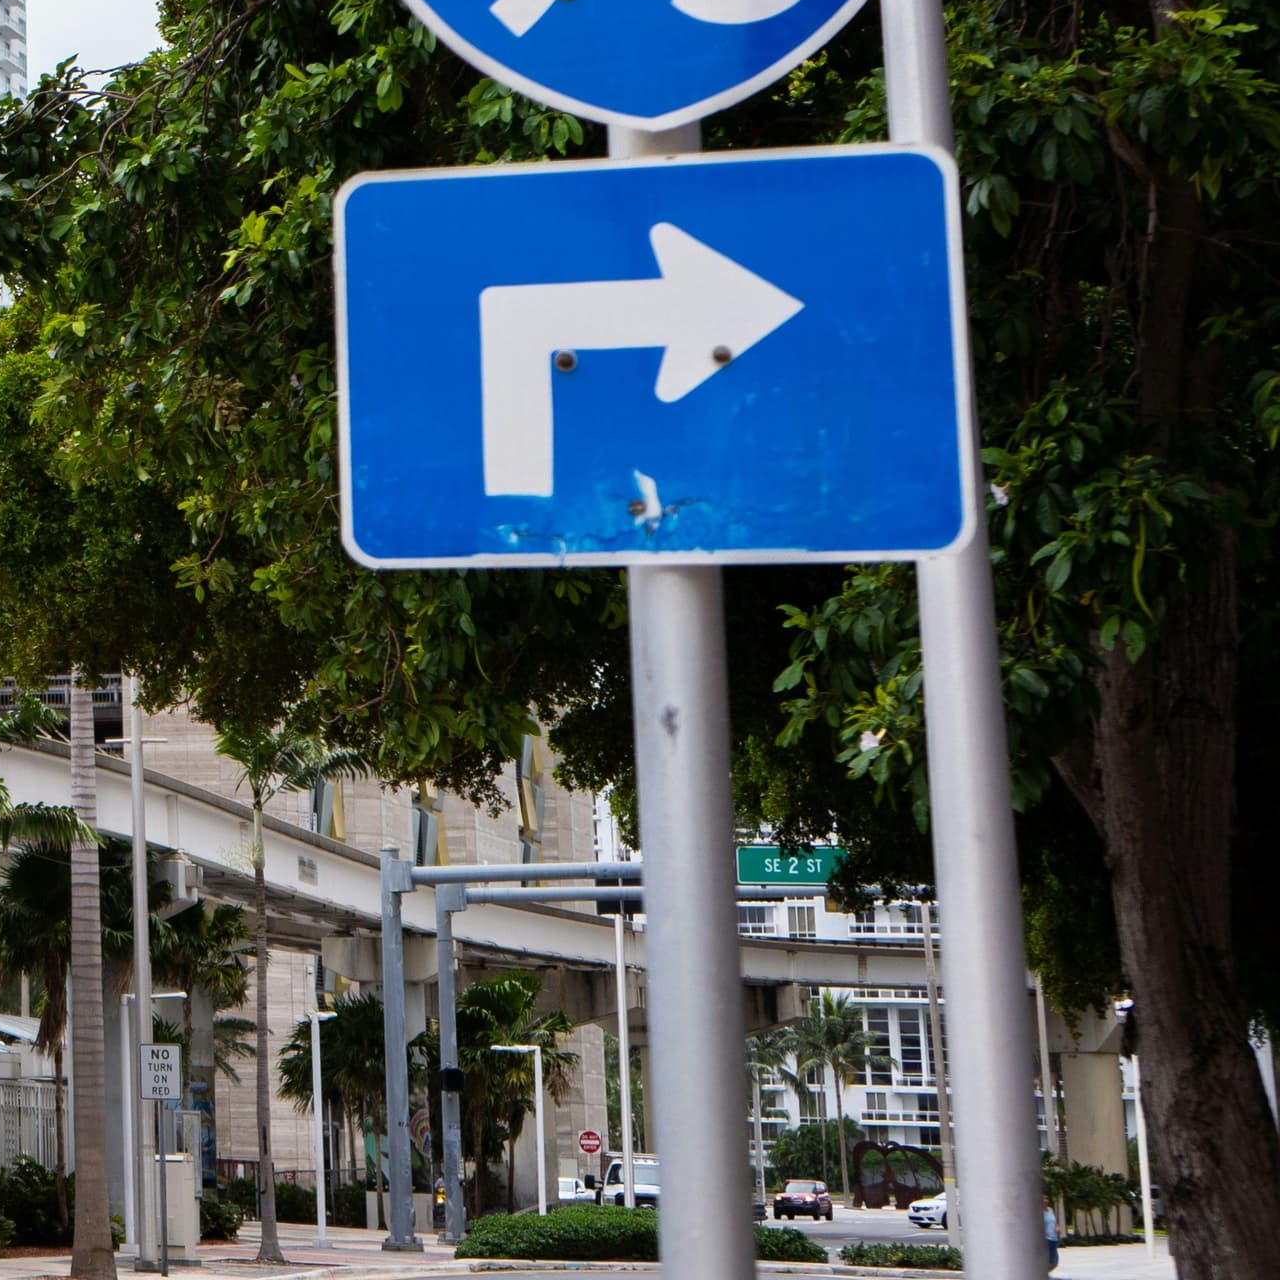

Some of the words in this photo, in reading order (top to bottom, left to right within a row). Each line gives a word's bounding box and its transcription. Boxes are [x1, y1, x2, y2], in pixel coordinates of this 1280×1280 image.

[764, 858, 782, 873] SE
[788, 856, 799, 874] 2
[806, 858, 823, 873] ST
[151, 1049, 170, 1060] NO
[147, 1062, 173, 1072] TURN
[153, 1074, 168, 1084] ON
[151, 1086, 170, 1096] RED
